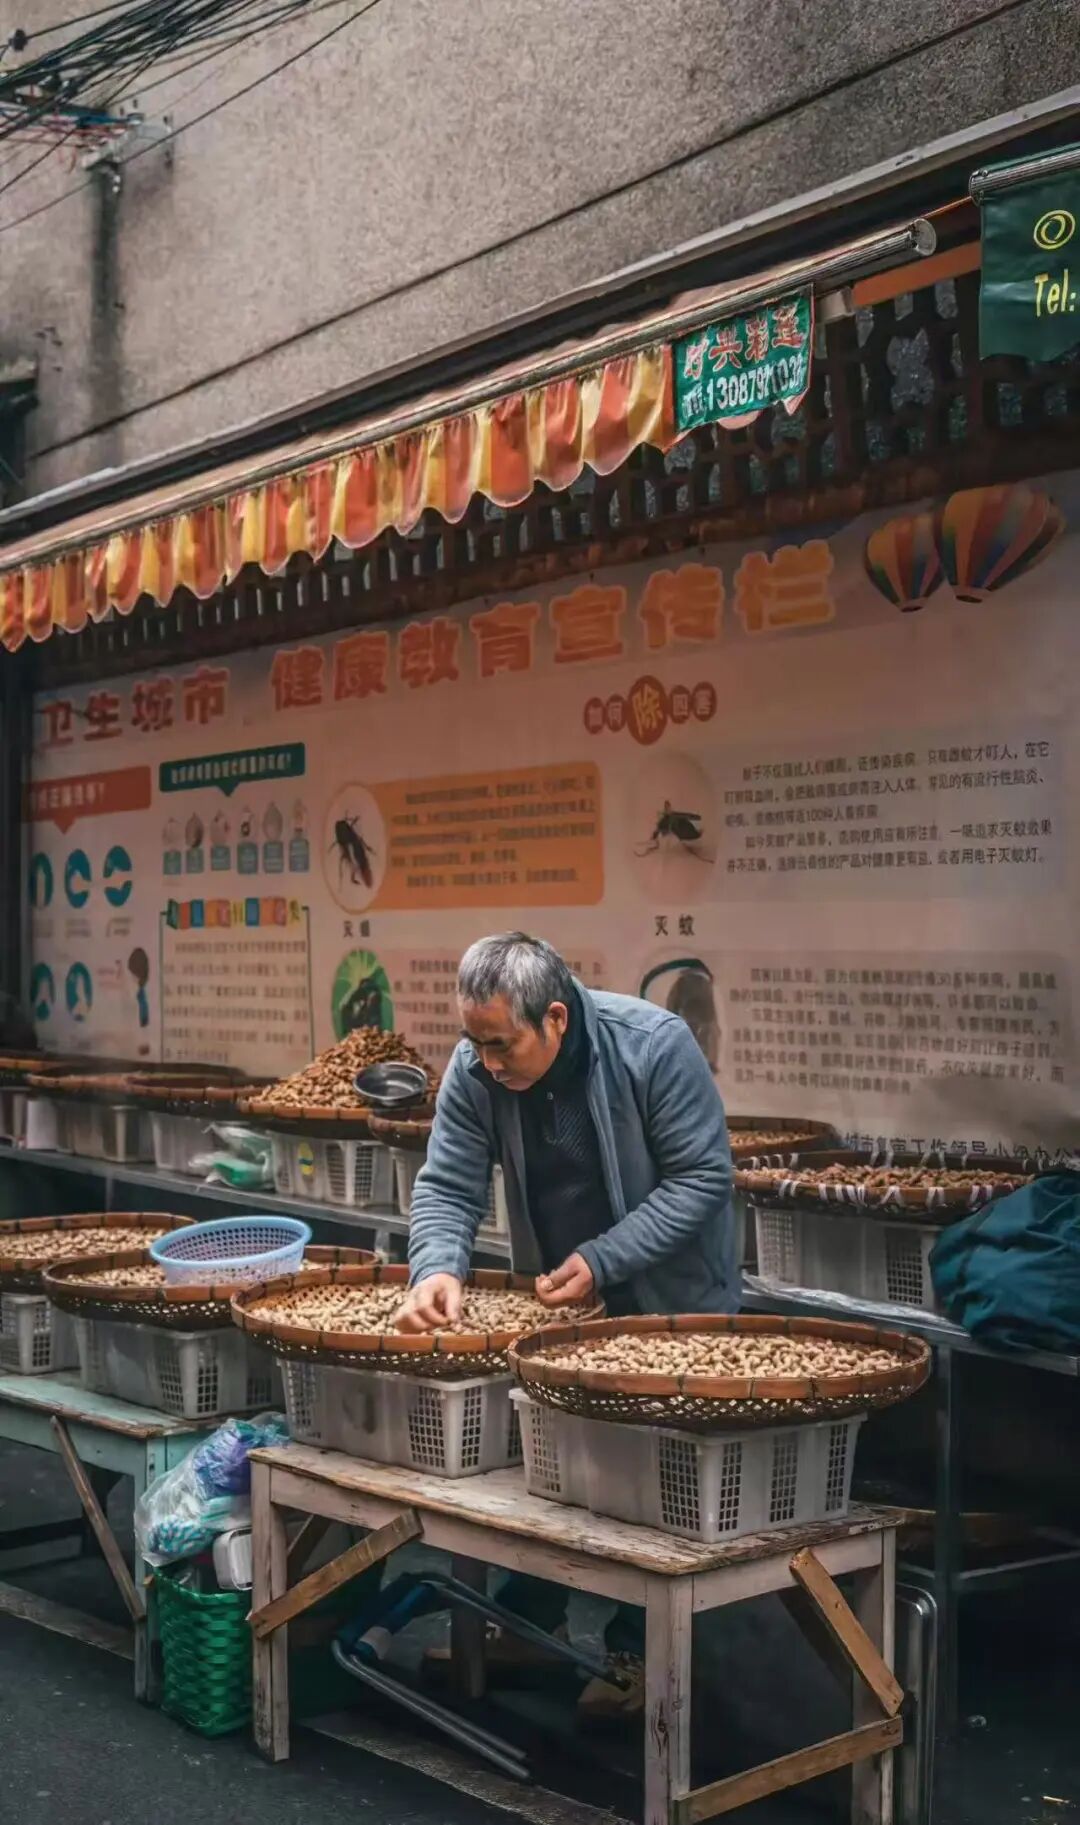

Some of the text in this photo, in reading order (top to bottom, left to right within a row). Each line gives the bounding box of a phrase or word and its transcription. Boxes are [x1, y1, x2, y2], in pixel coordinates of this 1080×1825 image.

[1034, 268, 1076, 317] Tel:
[37, 540, 836, 747] 卫生城市 健康教育宣传栏
[343, 919, 370, 938] 灭
[654, 914, 696, 937] 灭蚊
